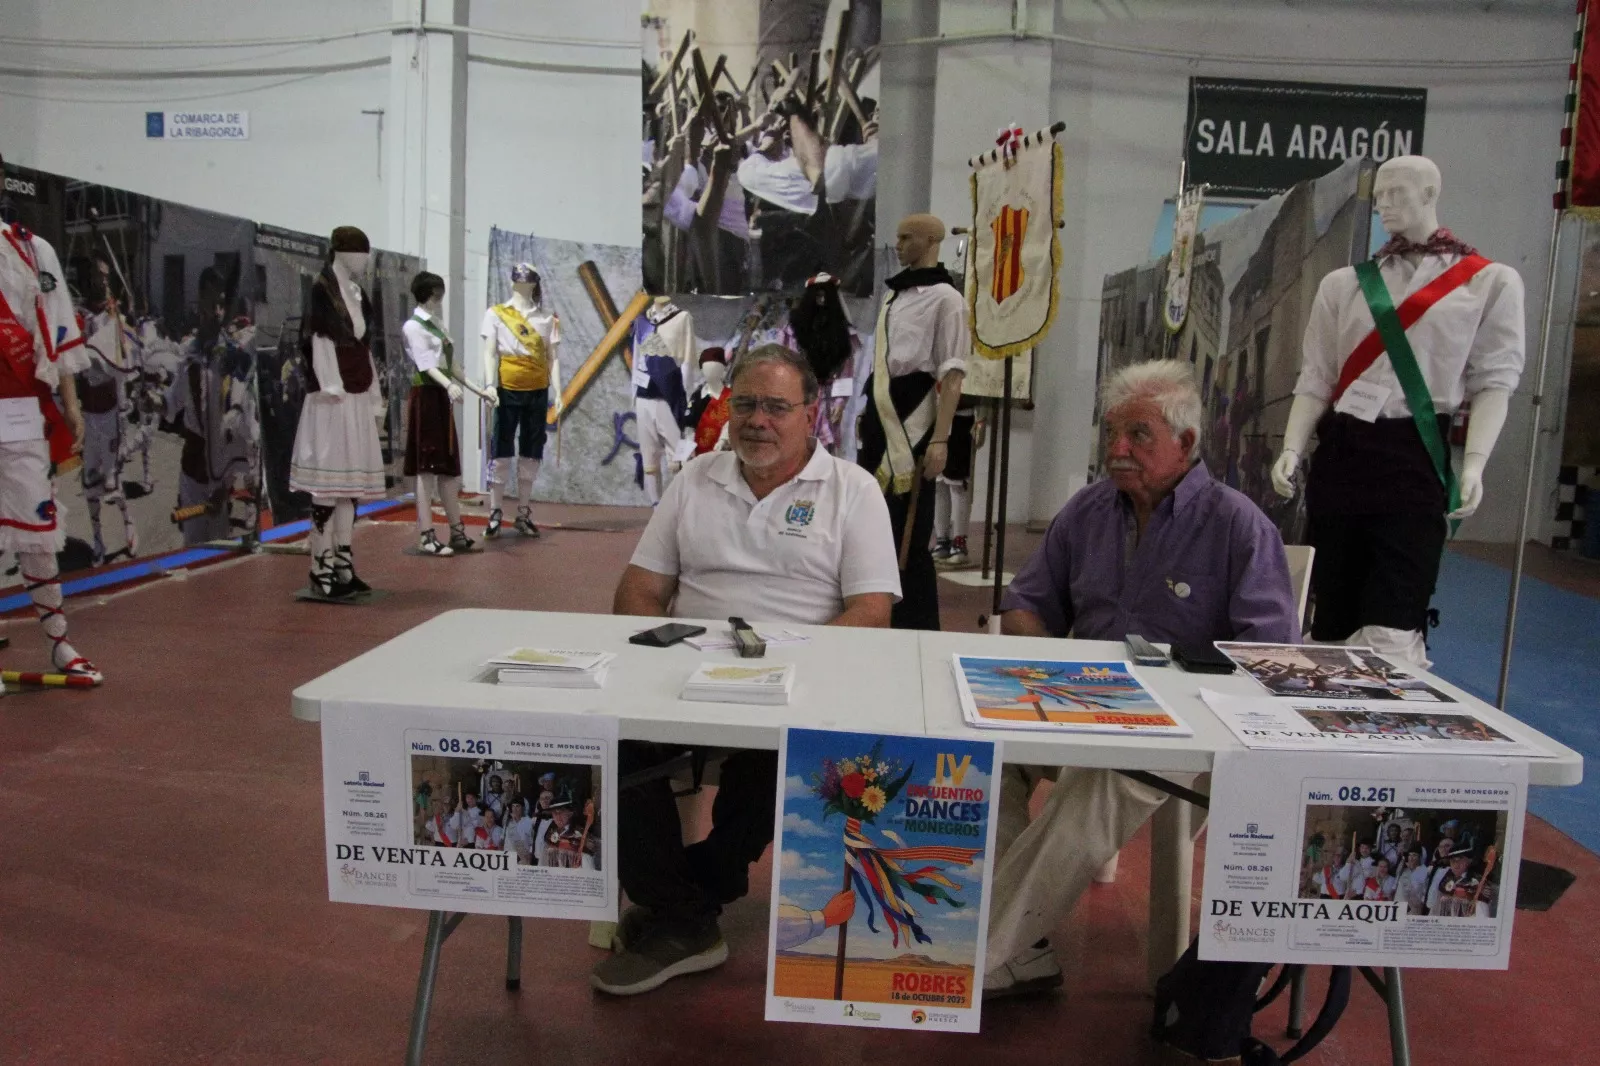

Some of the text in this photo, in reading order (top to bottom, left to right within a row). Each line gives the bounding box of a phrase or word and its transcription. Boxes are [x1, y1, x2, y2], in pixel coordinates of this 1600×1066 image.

[173, 113, 240, 124] COMARCA DE
[170, 127, 244, 138] LA RIBAGORZA
[1196, 118, 1412, 162] SALA ARAGÓN
[1280, 731, 1357, 739] VENTA
[411, 741, 435, 752] Núm.
[438, 737, 492, 755] 08.261
[510, 740, 542, 749] DANCES
[557, 743, 601, 751] MONEGROS
[936, 753, 972, 786] IV
[906, 783, 985, 802] ENCUENTRO
[1308, 791, 1333, 801] Núm.
[1338, 786, 1395, 803] 08.261
[1415, 787, 1448, 795] DANCES
[905, 798, 982, 823] DANCES
[904, 818, 981, 837] MONEGROS
[336, 844, 510, 872] DE VENTA AQUÍ
[355, 871, 397, 882] DANCES
[1223, 864, 1273, 873] Núm. 08.261
[1210, 899, 1399, 924] DE VENTA AQUÍ
[1229, 927, 1276, 937] DANCES
[892, 972, 966, 995] ROBRES
[891, 991, 966, 1004] 18 de OCTUBRE 2025
